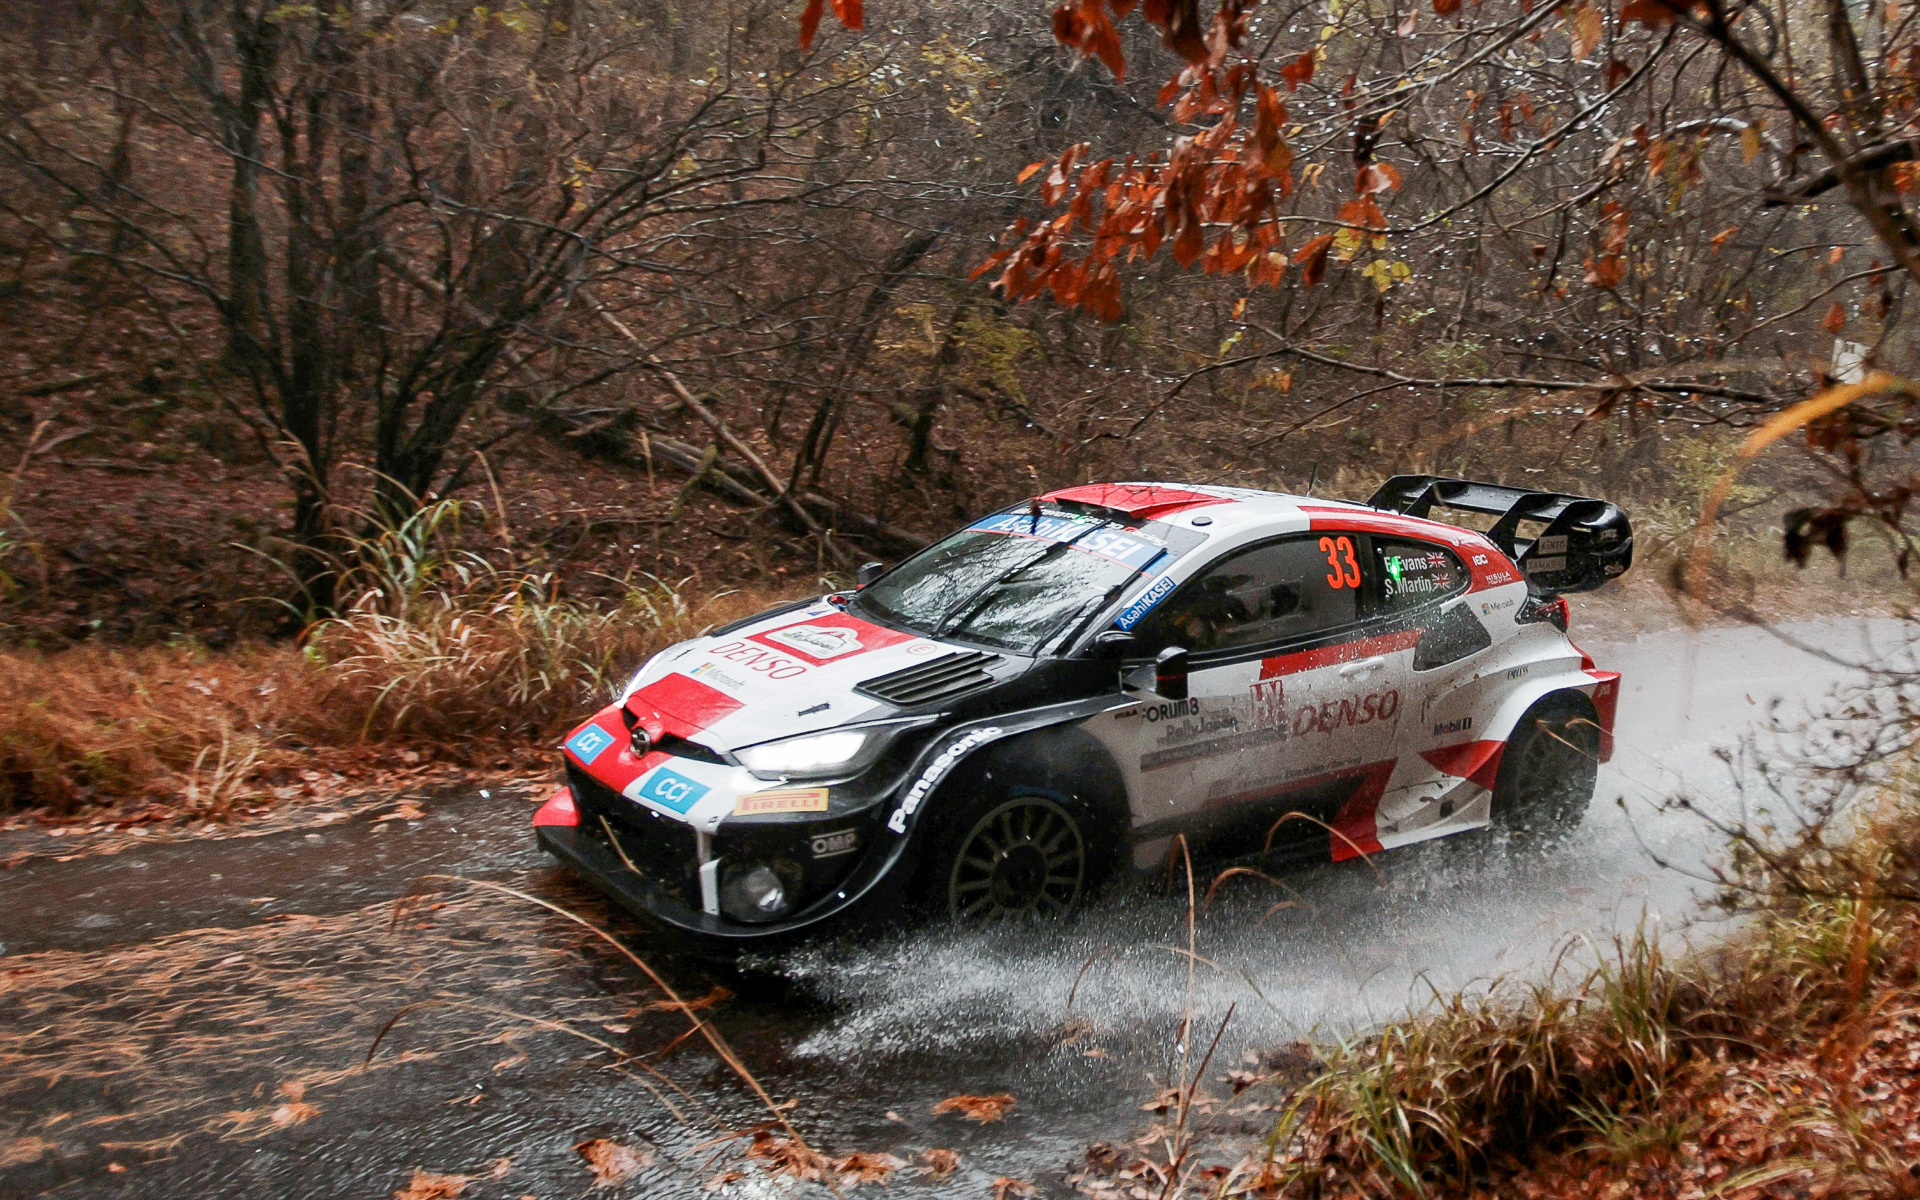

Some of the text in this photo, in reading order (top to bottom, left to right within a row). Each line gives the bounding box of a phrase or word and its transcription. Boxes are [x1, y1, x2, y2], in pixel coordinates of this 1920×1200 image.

[1319, 536, 1361, 589] 33
[1383, 555, 1428, 573] EEvans
[1384, 575, 1433, 595] S.Martin
[1485, 571, 1511, 582] NISULA
[1120, 577, 1174, 629] AsahiKASEI
[709, 641, 807, 680] DENSO
[1141, 697, 1200, 722] ORUM8
[1292, 690, 1399, 736] DENSO
[1433, 719, 1461, 736] Mobil
[887, 726, 1003, 834] Panasonic
[741, 792, 821, 811] PIRELLI
[811, 832, 857, 854] OMP
